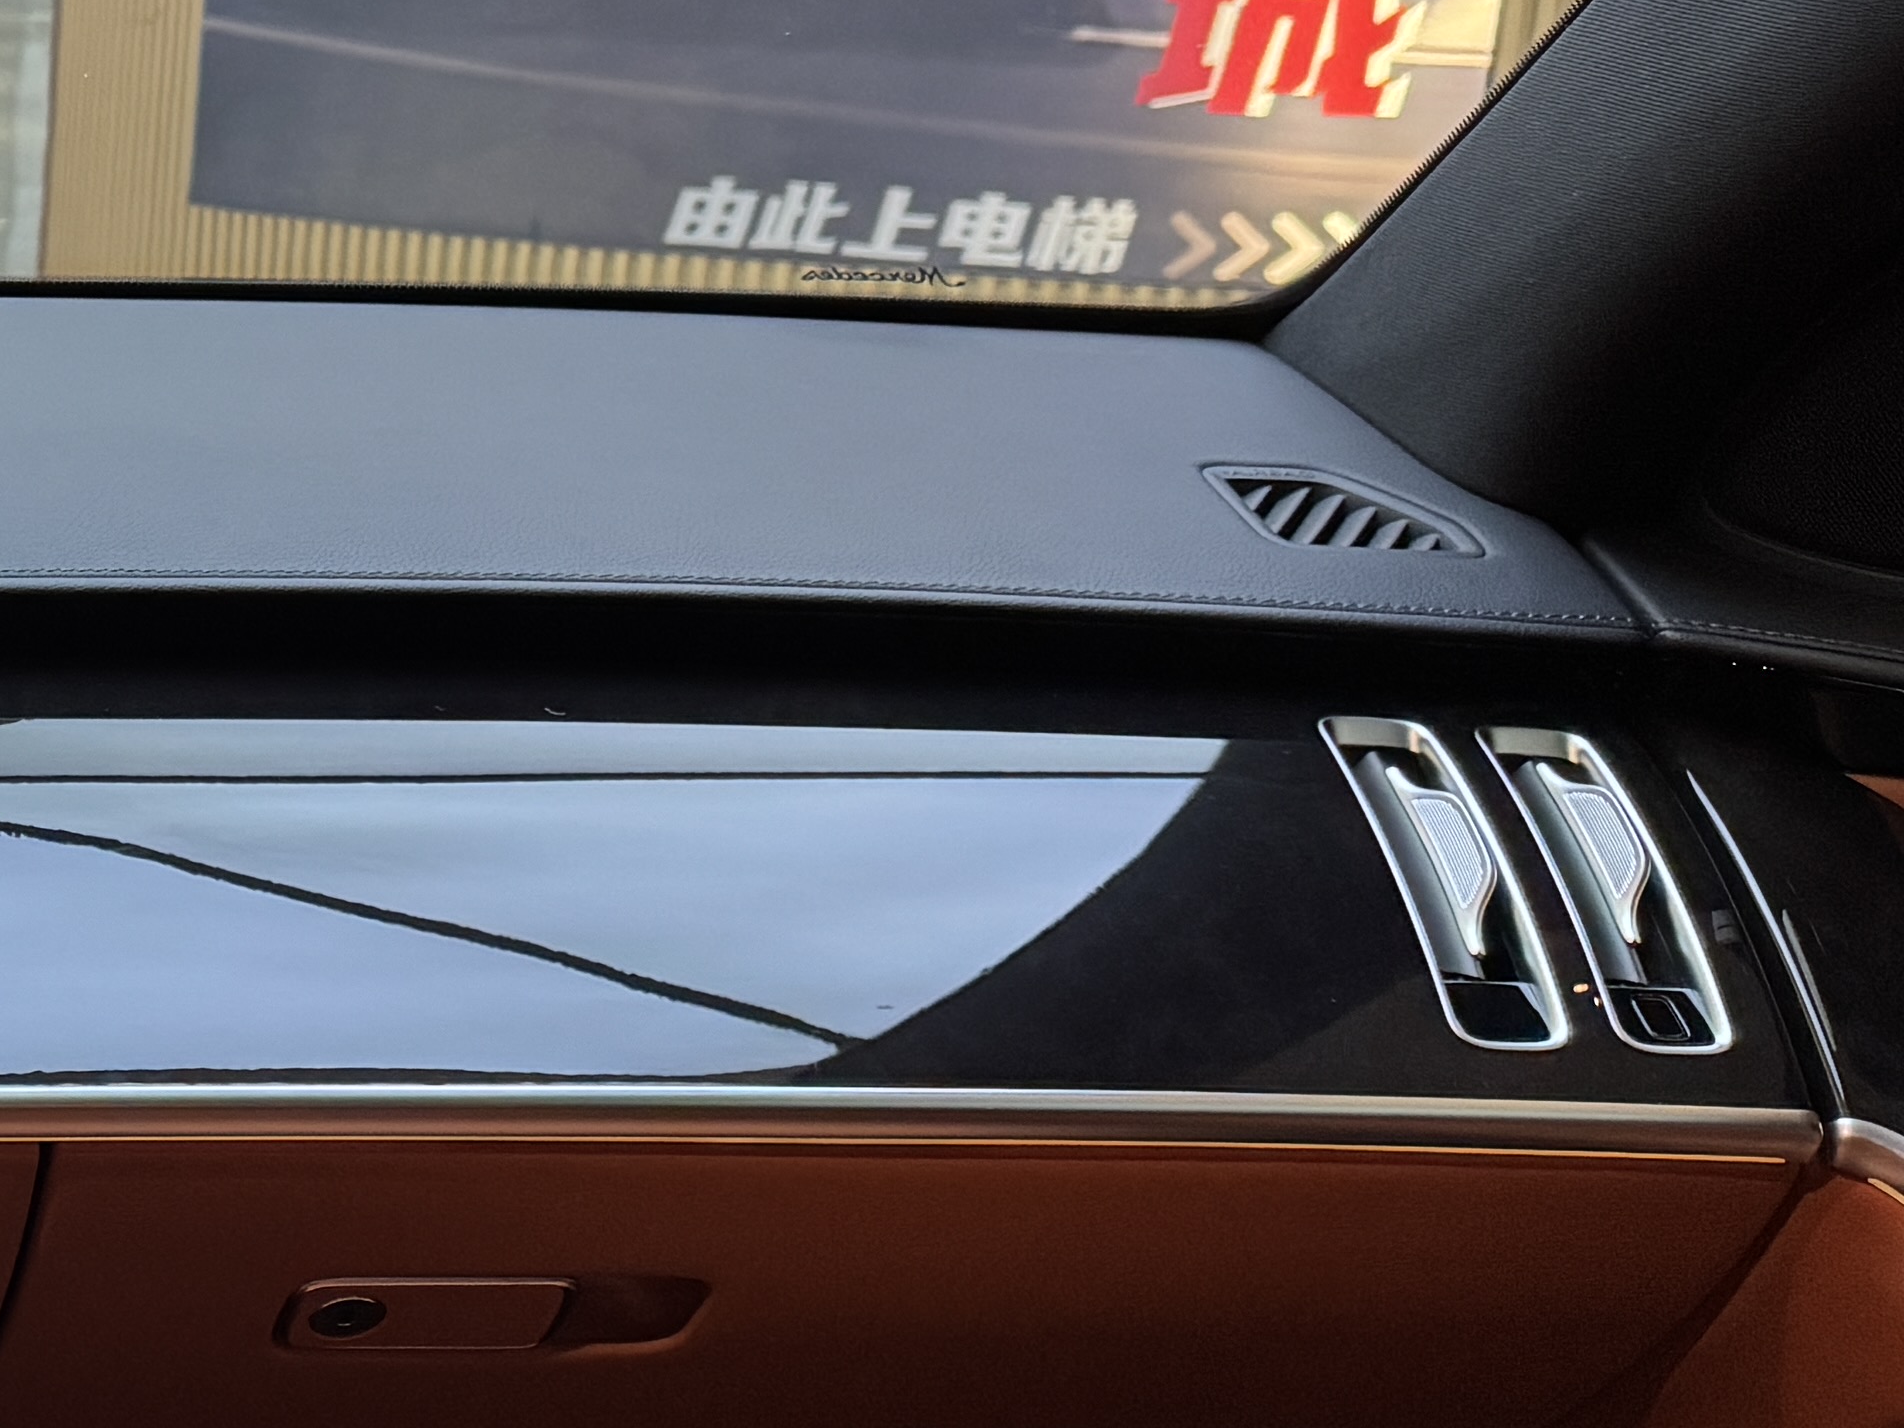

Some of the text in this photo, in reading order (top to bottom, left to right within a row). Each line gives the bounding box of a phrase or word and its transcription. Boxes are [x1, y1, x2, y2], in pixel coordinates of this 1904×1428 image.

[661, 175, 1138, 275] 由此上电梯
